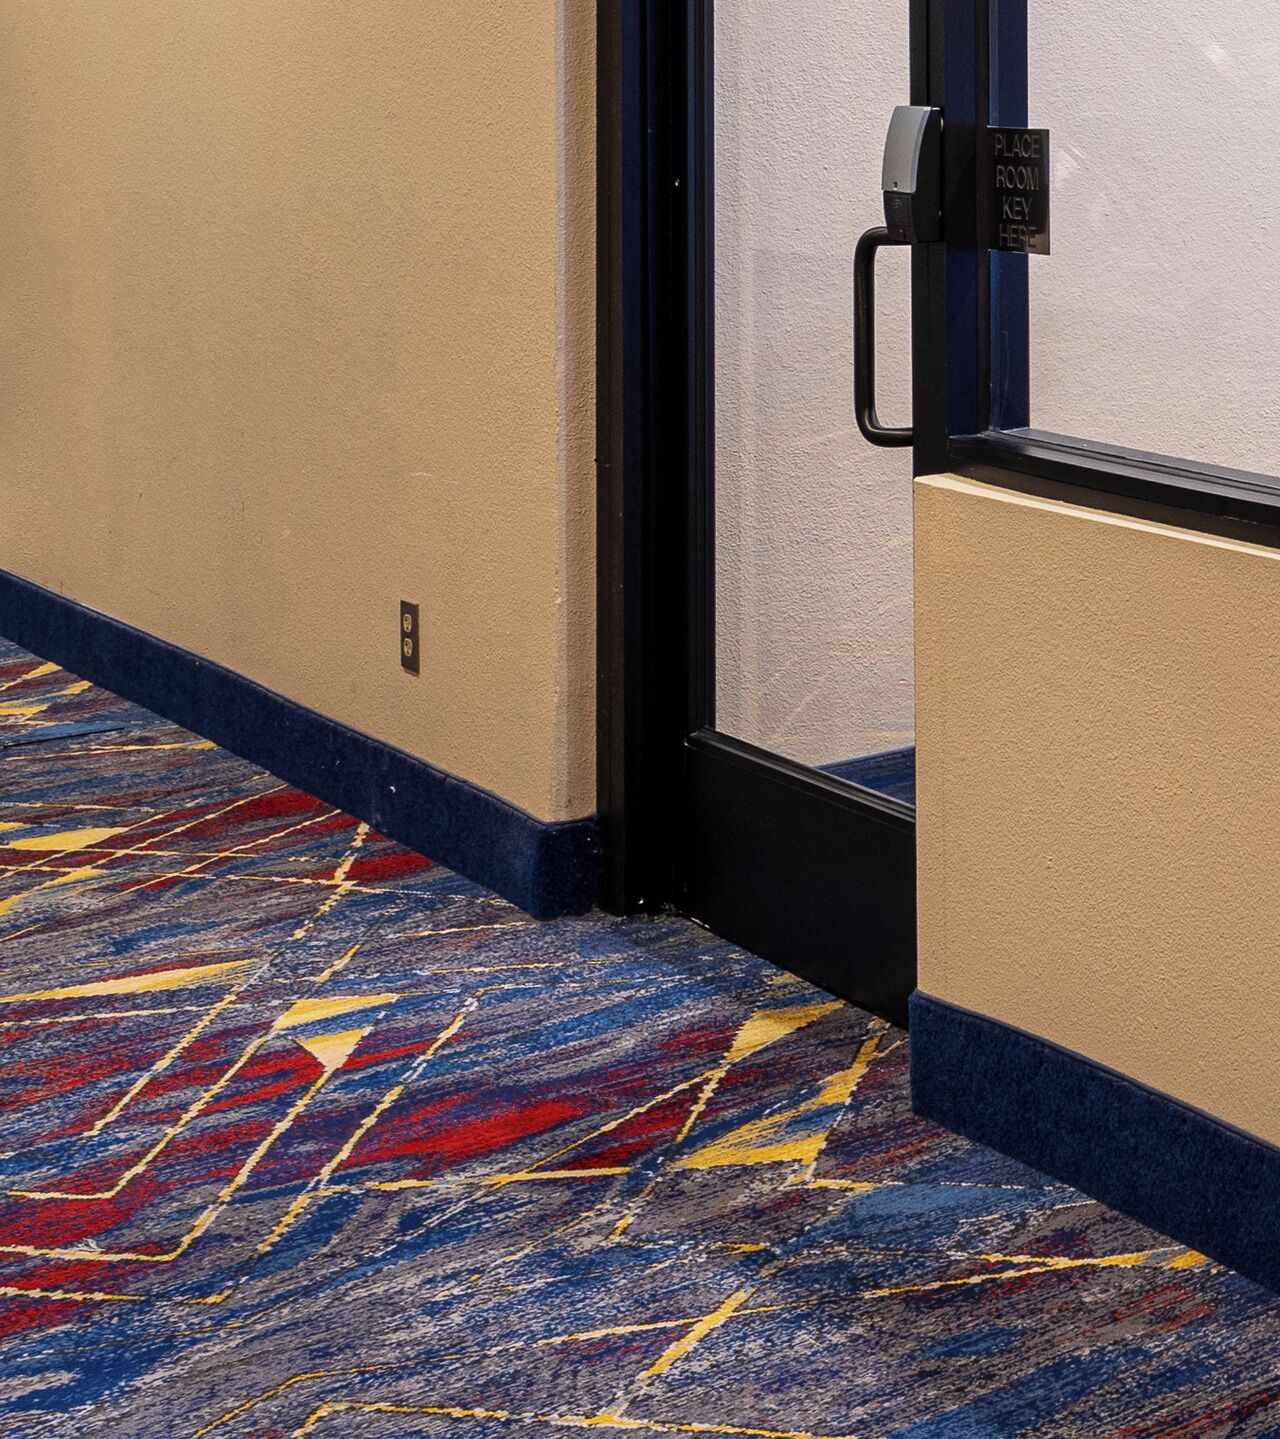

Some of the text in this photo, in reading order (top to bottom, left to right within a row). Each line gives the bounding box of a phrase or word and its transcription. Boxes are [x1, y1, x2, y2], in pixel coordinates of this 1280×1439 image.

[994, 134, 1040, 158] PLACE
[996, 165, 1040, 190] ROOM
[1002, 196, 1032, 221] KEY
[999, 223, 1038, 249] HERE
